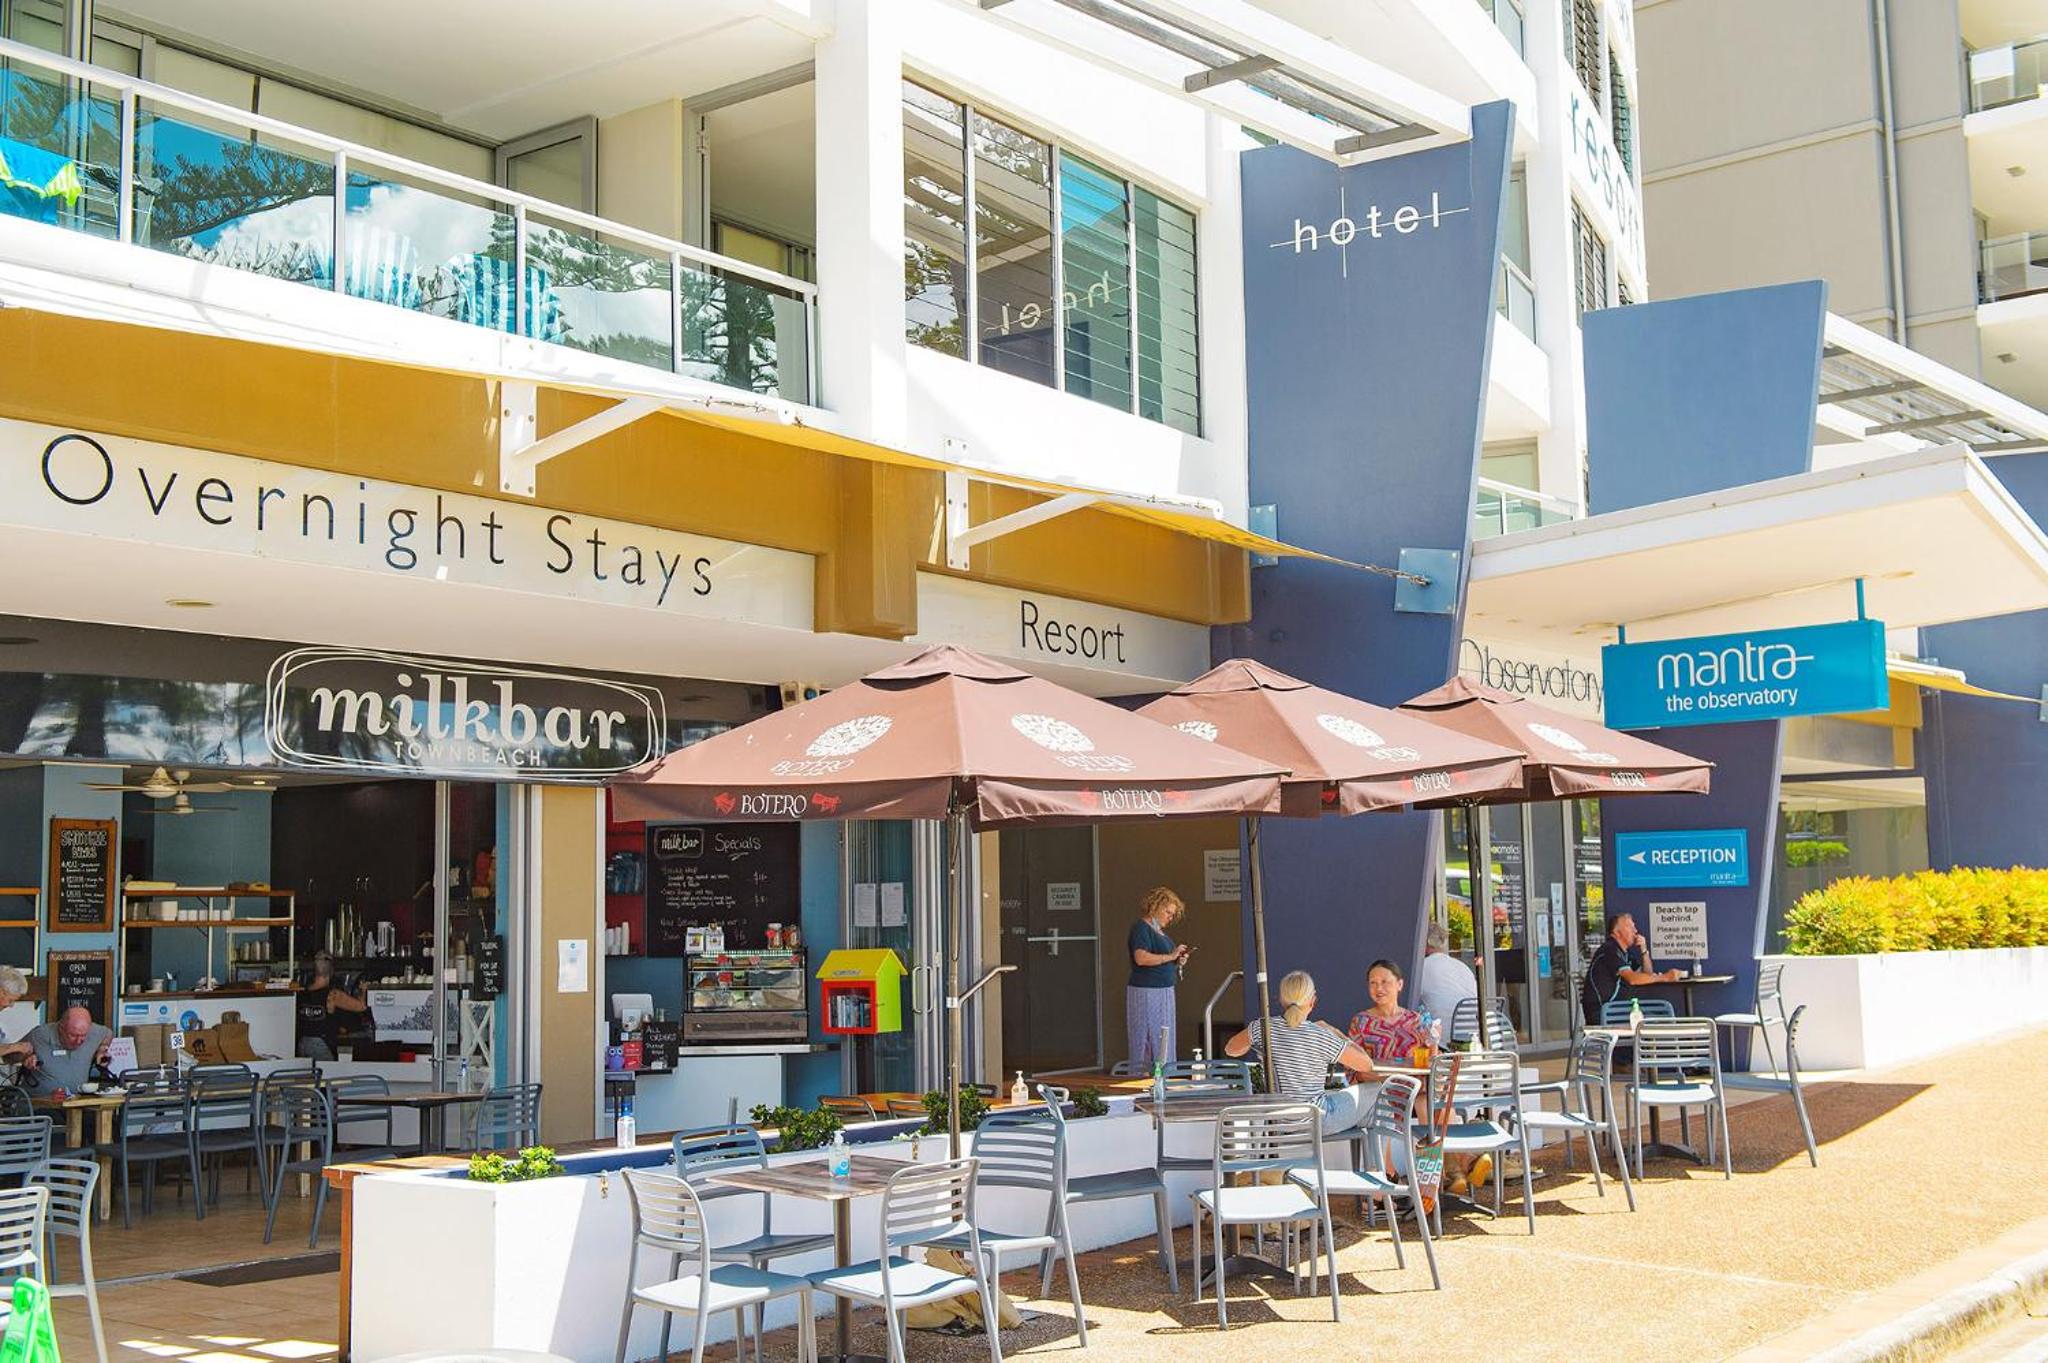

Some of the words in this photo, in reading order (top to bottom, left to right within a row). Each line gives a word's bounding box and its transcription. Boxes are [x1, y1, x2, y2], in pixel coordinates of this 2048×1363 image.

[1294, 192, 1440, 253] hotel
[42, 434, 505, 570] Overnight
[546, 514, 712, 606] Stays
[1021, 600, 1126, 664] Resort
[1658, 641, 1814, 690] mantra
[310, 673, 626, 750] milkbar
[1666, 695, 1693, 712] the
[1698, 688, 1799, 710] observatory
[394, 741, 542, 768] TOWNBEACH
[741, 794, 807, 818] BOTERO
[1102, 788, 1165, 817] BOTERO
[714, 832, 762, 853] Specials
[1652, 848, 1736, 864] RECEPTION
[1656, 906, 1683, 914] Beach
[1684, 906, 1699, 915] tap
